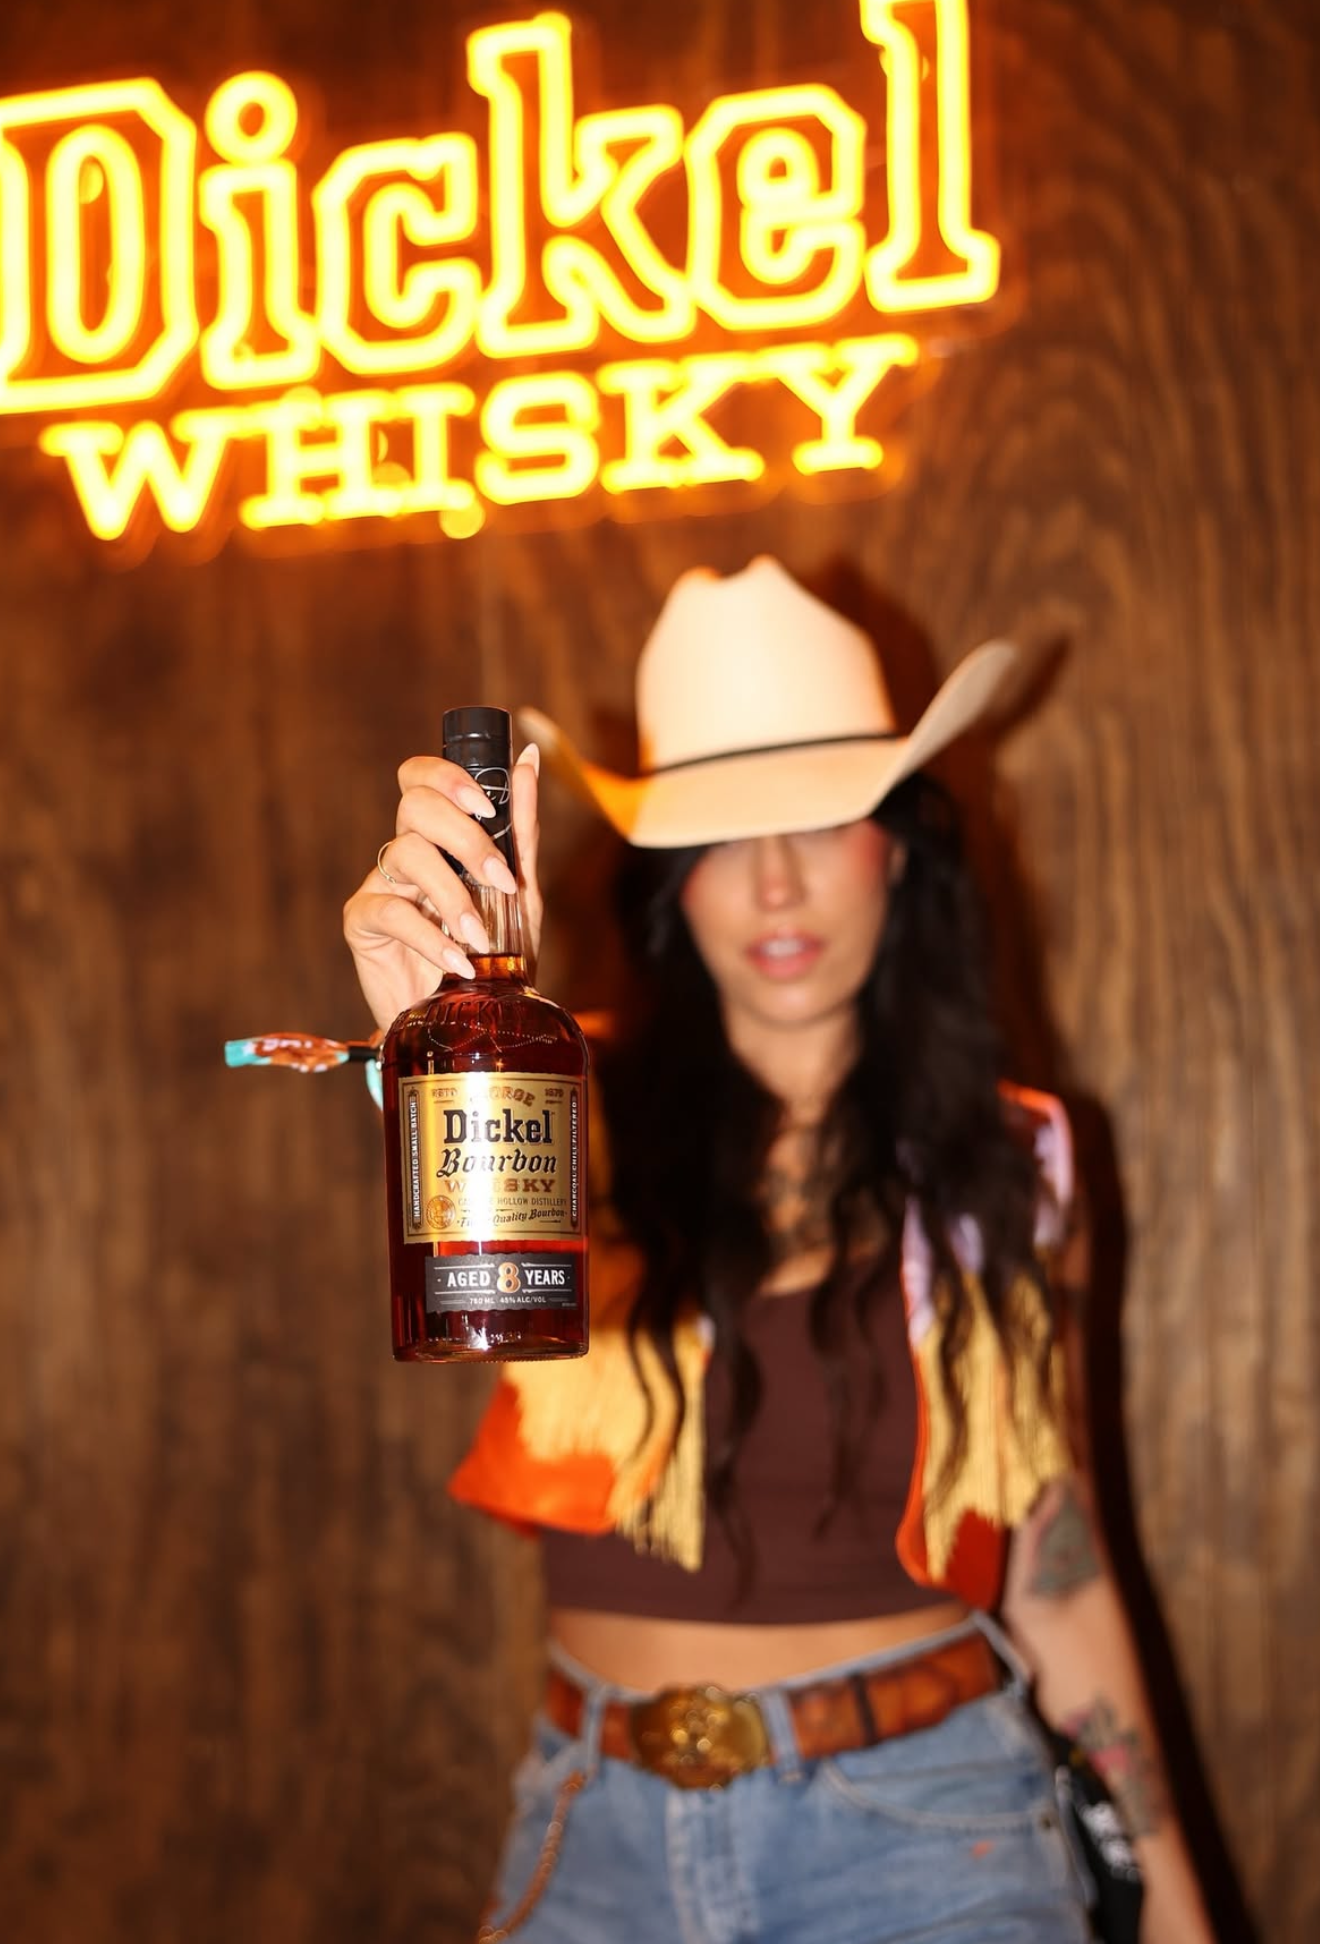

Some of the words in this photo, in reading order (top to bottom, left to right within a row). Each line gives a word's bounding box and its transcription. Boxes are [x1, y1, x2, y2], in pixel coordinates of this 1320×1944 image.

[0, 0, 1000, 412] Dickel
[42, 335, 918, 540] WHISKY
[410, 1101, 418, 1127] BATCH
[443, 1108, 553, 1144] Dickel
[411, 1128, 419, 1157] SMALL
[436, 1147, 558, 1178] Bourbon
[412, 1158, 421, 1218] HANDCRAFTED
[444, 1178, 556, 1193] WSKY
[493, 1212, 528, 1227] Quality
[528, 1207, 566, 1221] Bourbon
[497, 1197, 529, 1206] HOLLOW
[531, 1197, 568, 1207] DISTILLERY
[447, 1270, 491, 1288] AGED
[496, 1261, 522, 1294] 8
[524, 1269, 566, 1286] YEARS
